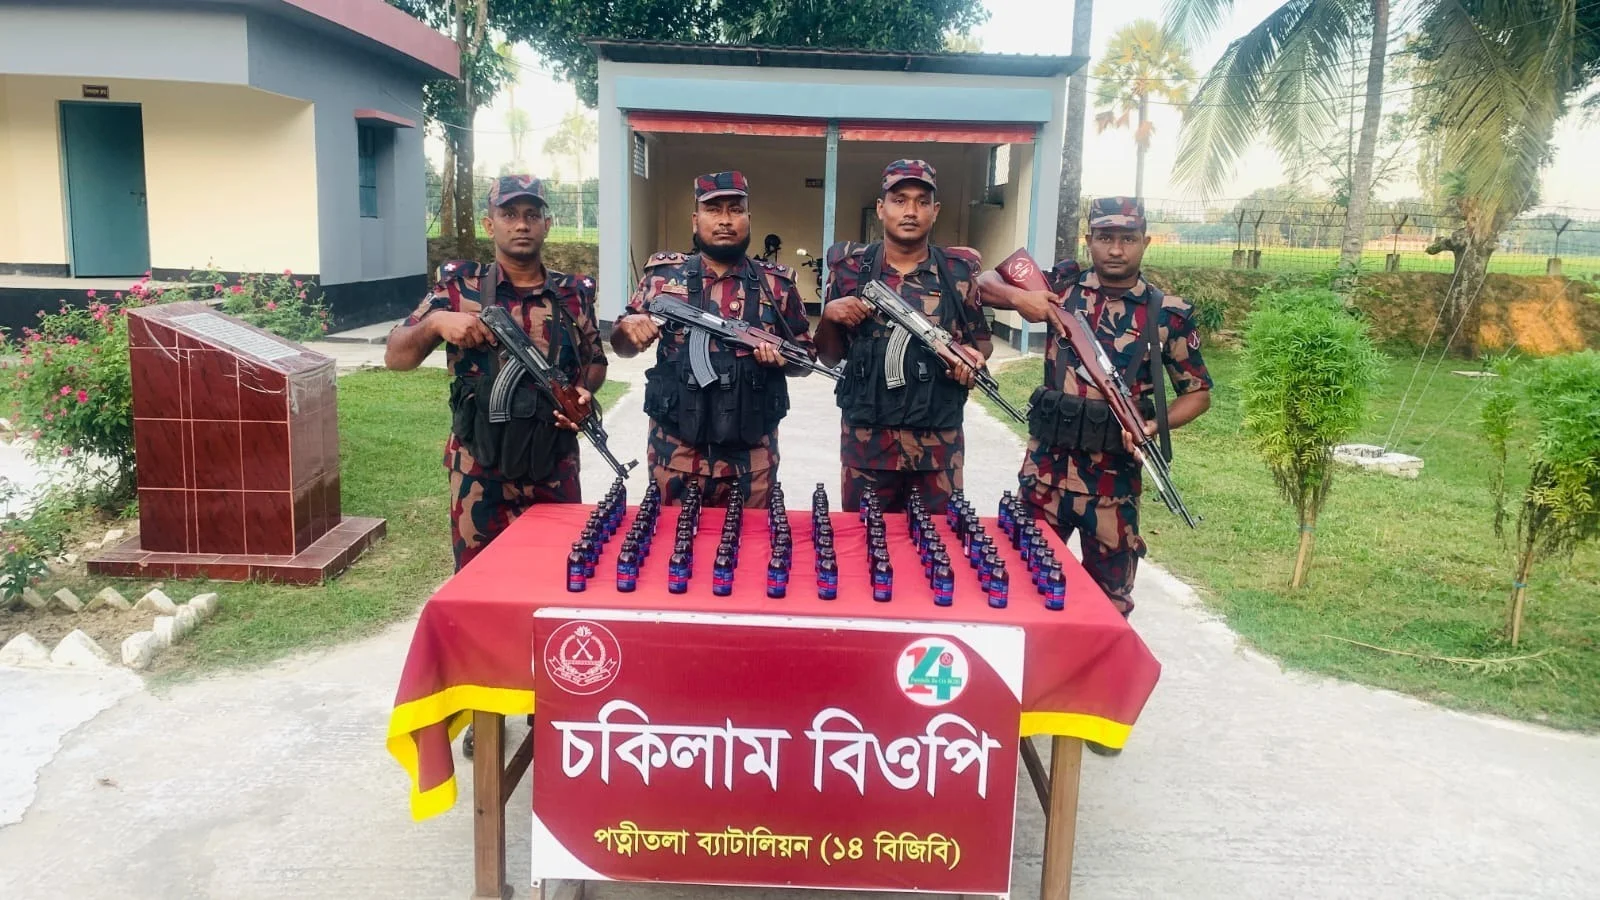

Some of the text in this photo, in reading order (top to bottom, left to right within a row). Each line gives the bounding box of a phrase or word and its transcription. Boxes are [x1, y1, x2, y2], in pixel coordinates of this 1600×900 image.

[552, 700, 1001, 799] চকিলাম বিওপি
[594, 821, 961, 870] পত্নীতলা ব্যাটালিয়ন (১৪ বিজিবি)
